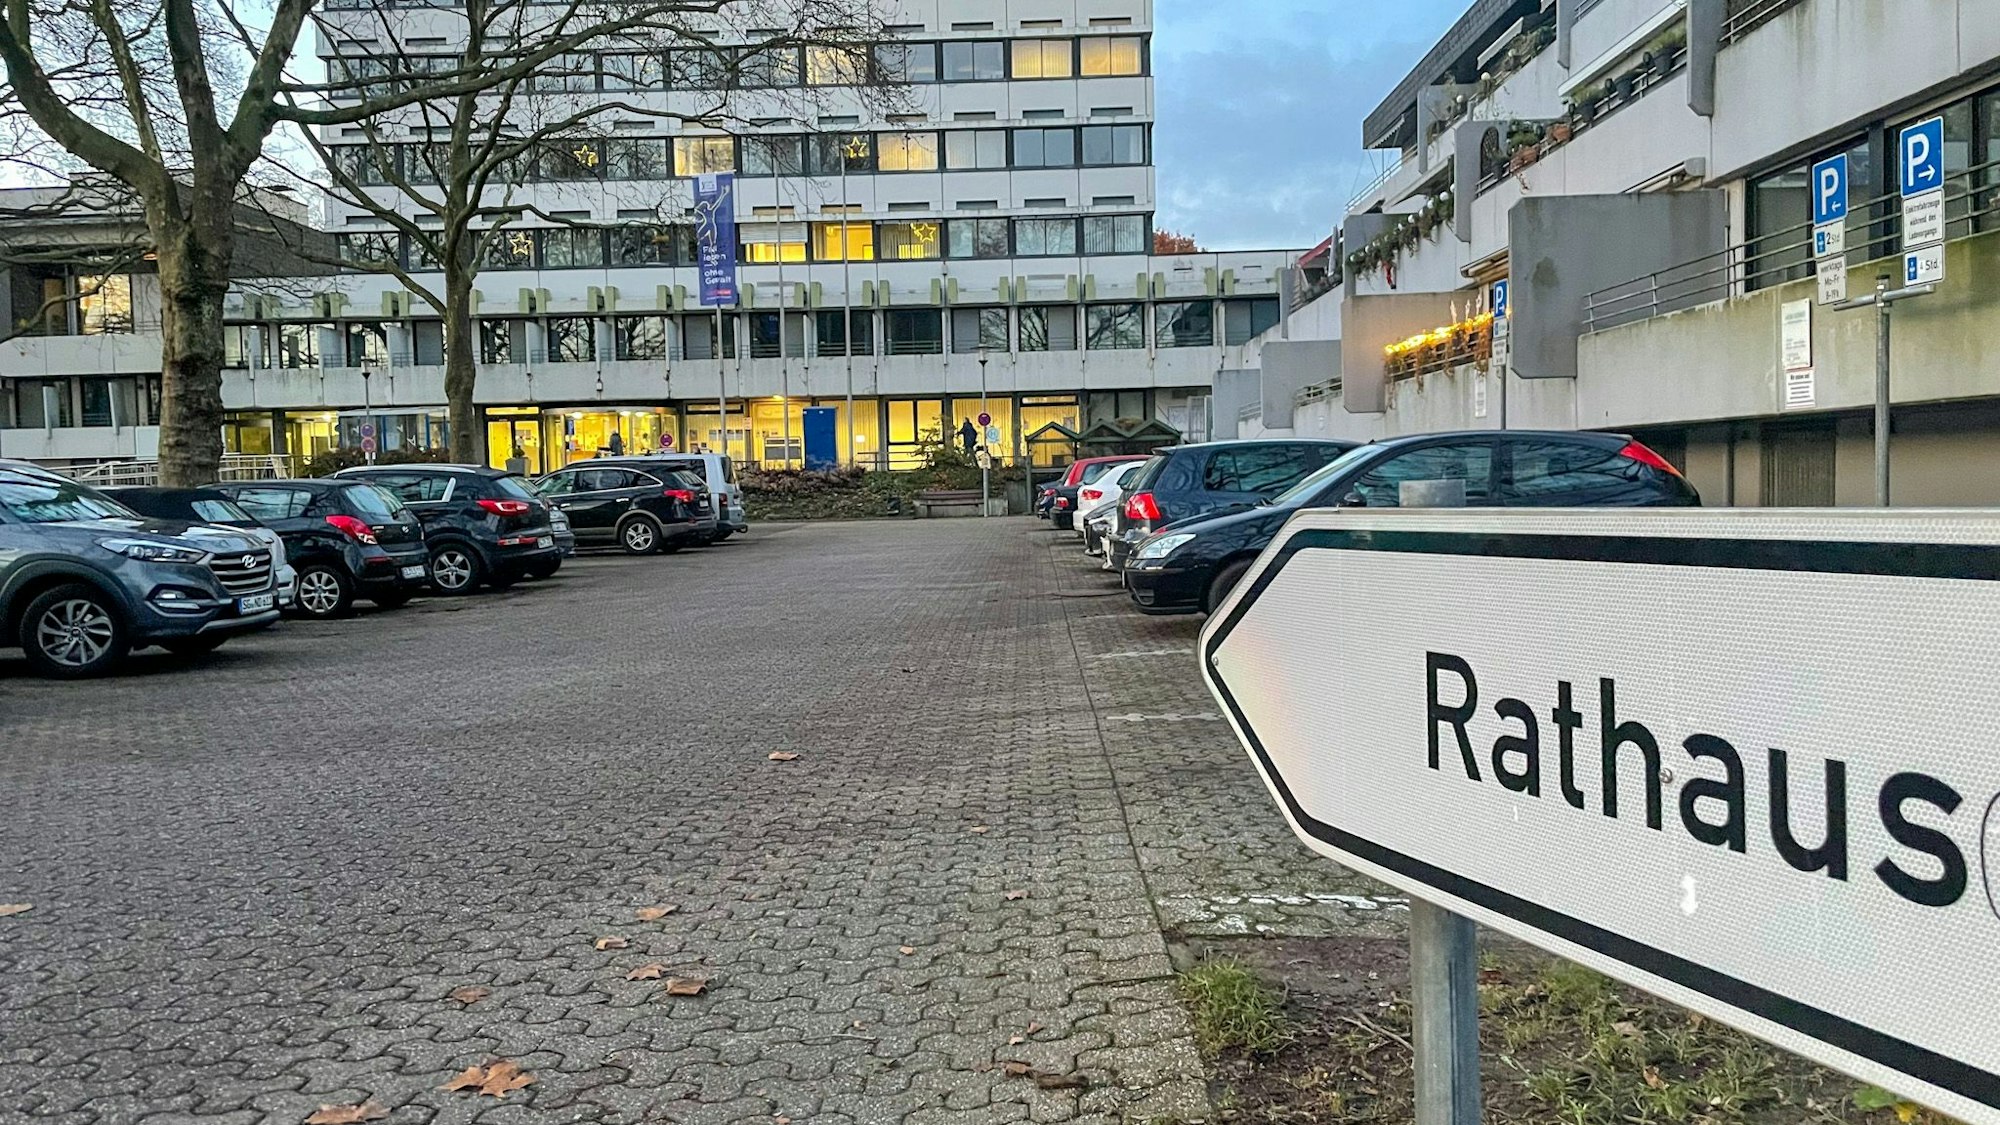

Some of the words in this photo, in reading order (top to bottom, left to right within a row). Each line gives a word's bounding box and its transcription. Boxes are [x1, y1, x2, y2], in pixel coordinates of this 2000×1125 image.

[1907, 133, 1930, 187] P
[1821, 167, 1839, 216] P
[1826, 232, 1831, 244] 2
[1426, 651, 1968, 906] Rathaus
